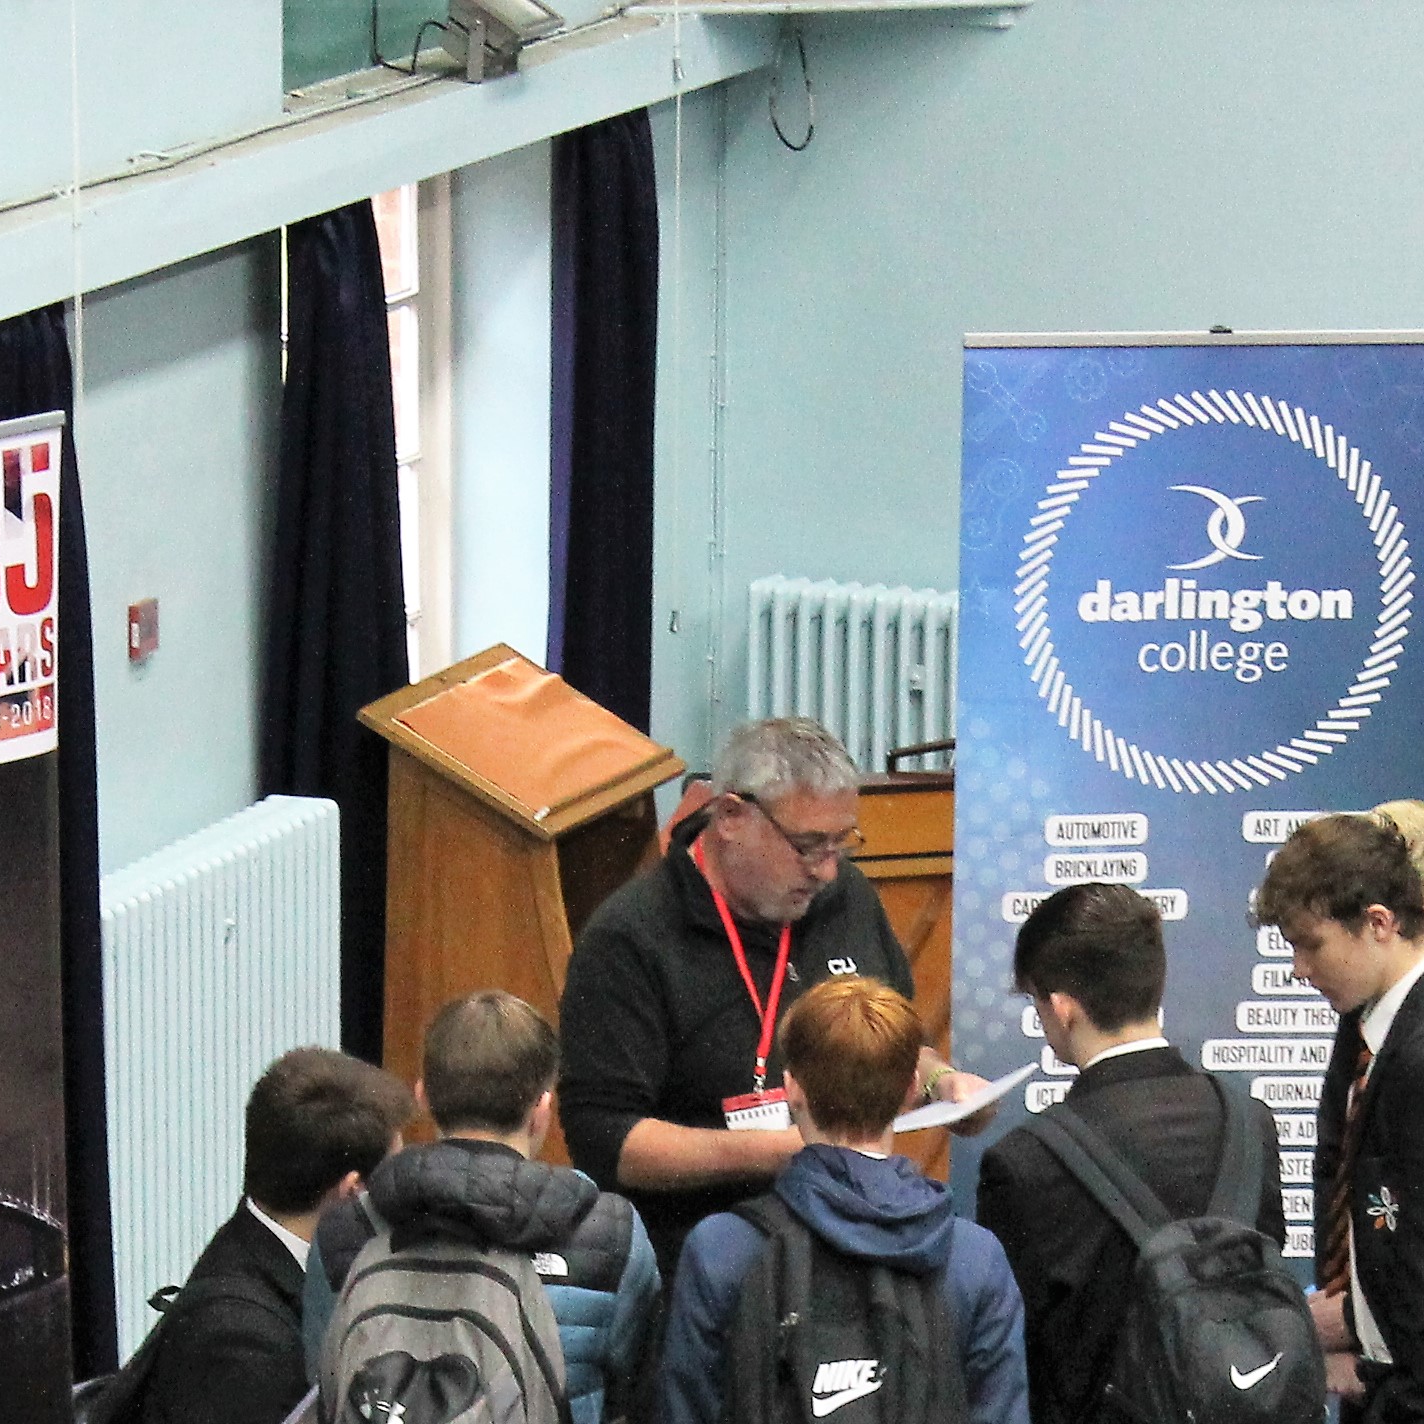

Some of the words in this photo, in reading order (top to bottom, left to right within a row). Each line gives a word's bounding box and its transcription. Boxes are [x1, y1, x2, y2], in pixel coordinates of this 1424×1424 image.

[1077, 578, 1353, 633] darlington
[1138, 629, 1288, 682] college
[1056, 821, 1138, 840] AUTOMOTIVE
[1254, 818, 1280, 837] ART
[1055, 859, 1137, 879] BRICKLAYING
[1247, 1008, 1297, 1026] BEAUTY
[1212, 1046, 1293, 1064] HOSPITALITY
[1299, 1046, 1326, 1063] AND
[1037, 1087, 1056, 1106] ICT
[812, 1360, 880, 1394] NIKE
